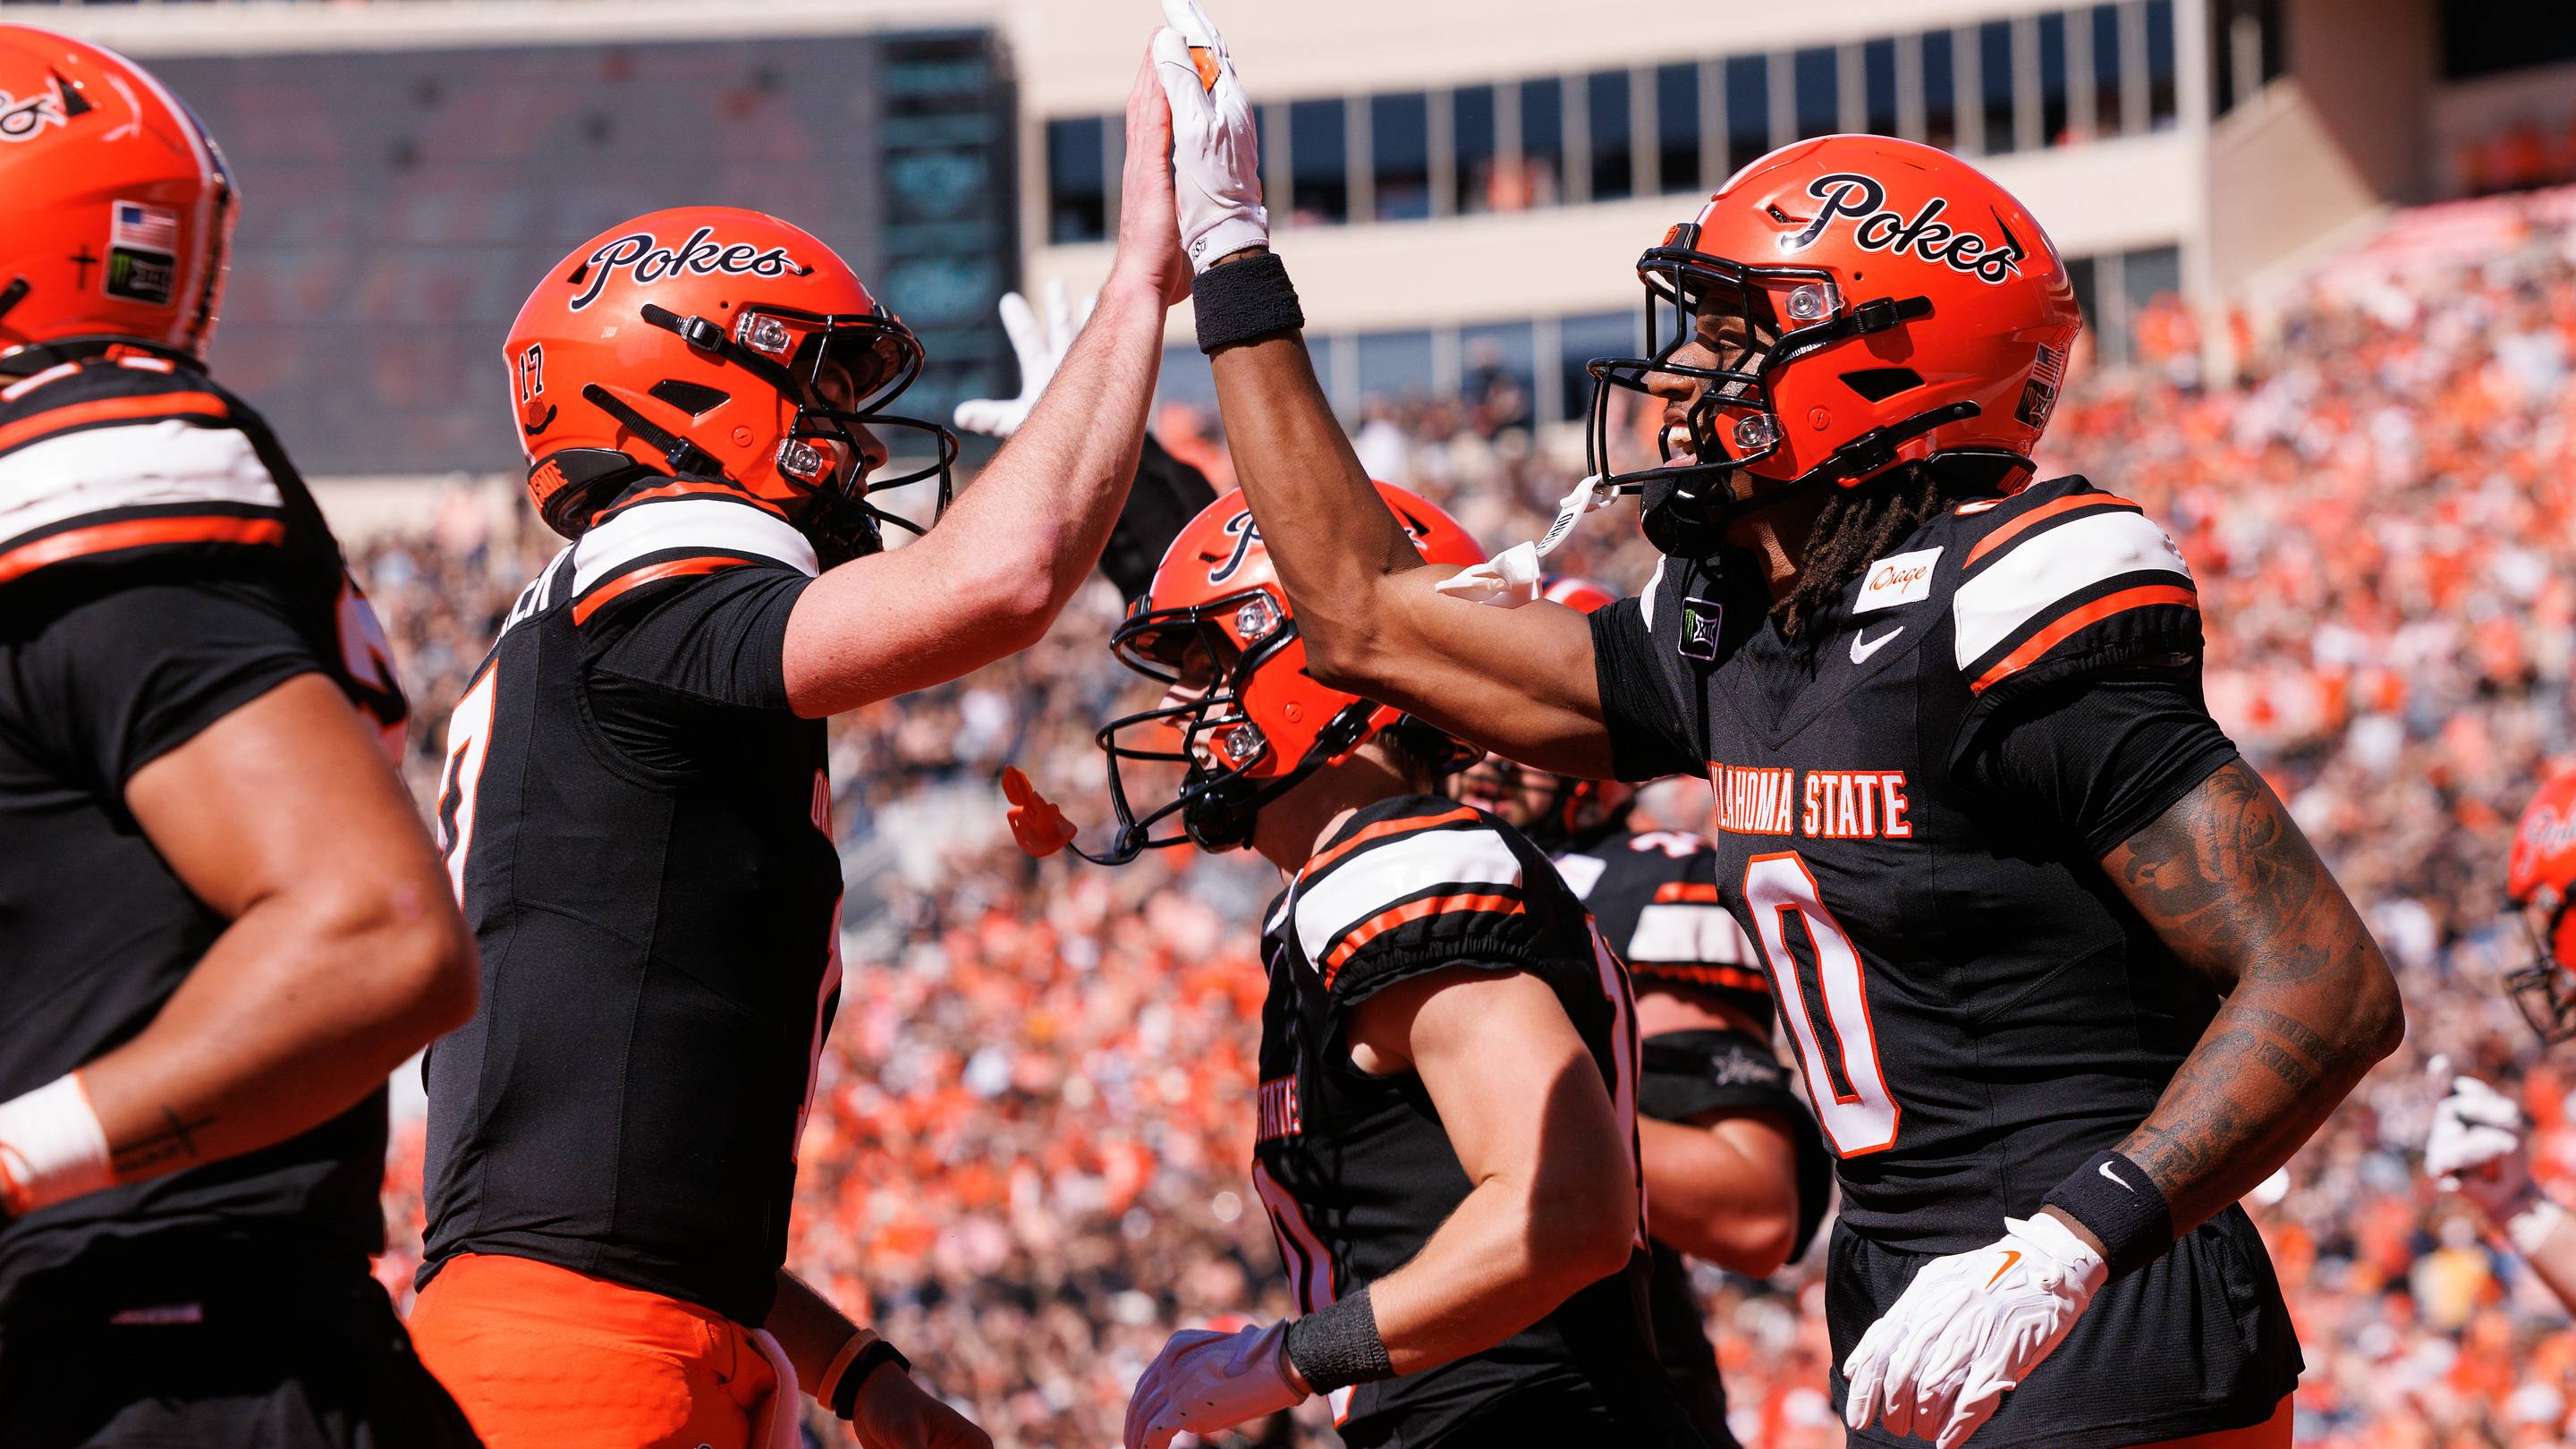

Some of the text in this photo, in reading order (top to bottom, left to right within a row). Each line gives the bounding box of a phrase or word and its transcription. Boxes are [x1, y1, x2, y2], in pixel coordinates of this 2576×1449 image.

[1778, 172, 2024, 285] Pokes
[569, 226, 803, 312] Pokes
[520, 342, 545, 405] 17
[1868, 565, 1928, 595] Osage
[1801, 770, 1912, 839] STATE
[1742, 850, 1902, 1160] 0
